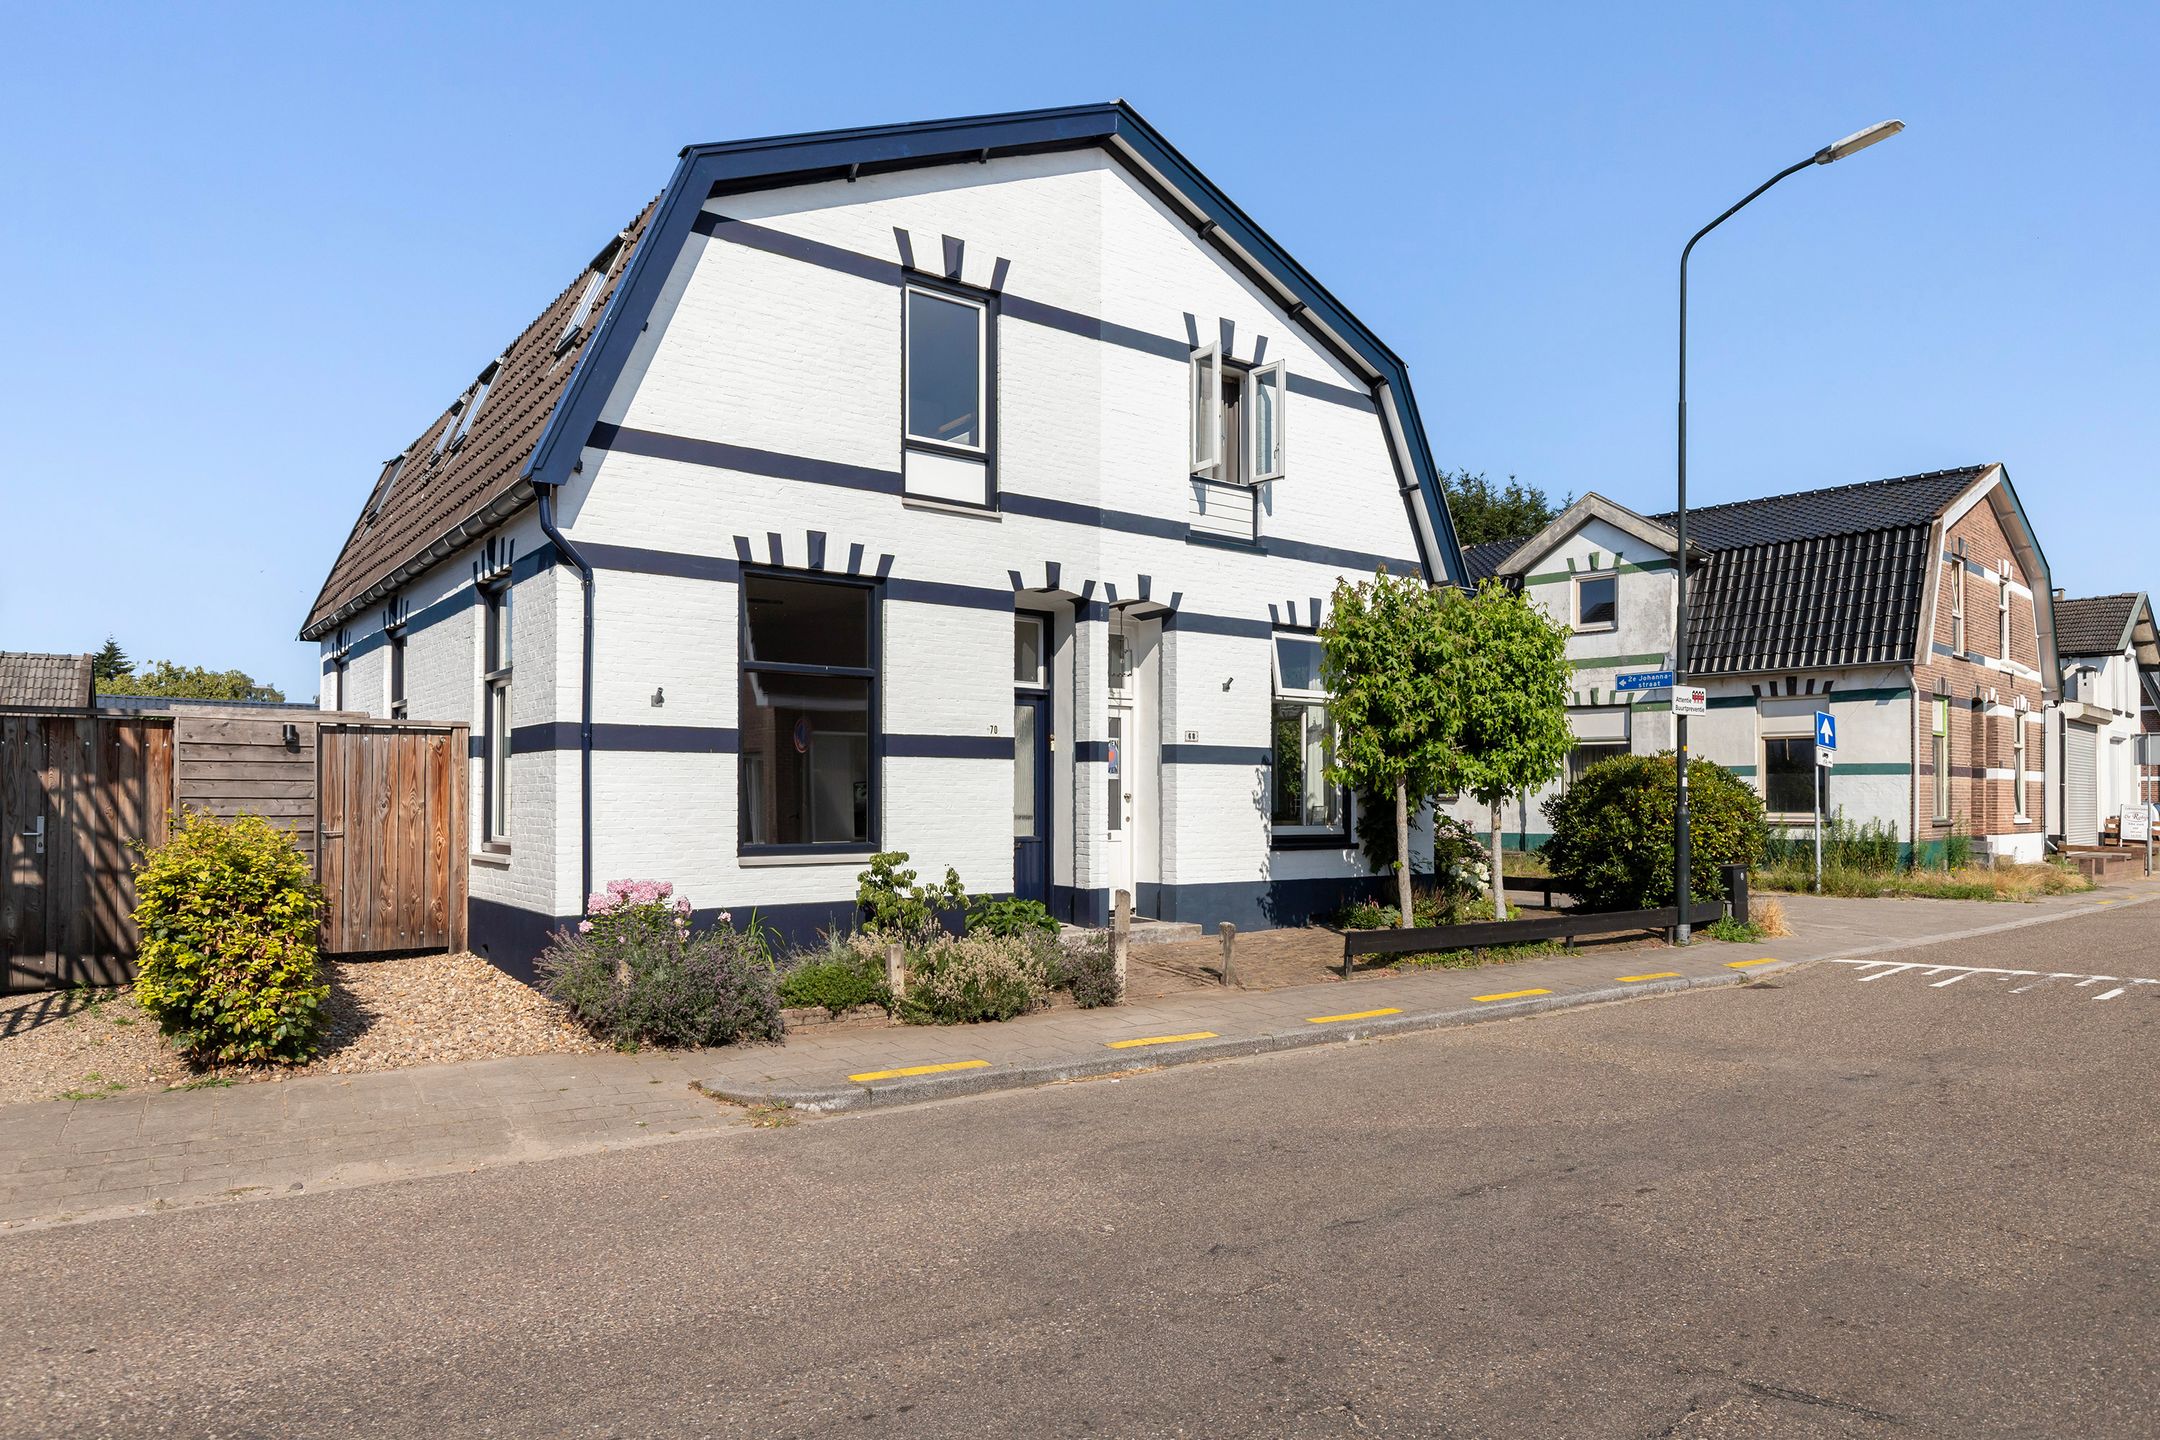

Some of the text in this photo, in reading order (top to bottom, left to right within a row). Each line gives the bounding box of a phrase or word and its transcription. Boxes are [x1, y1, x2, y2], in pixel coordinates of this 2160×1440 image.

[1638, 673, 1671, 682] Johanna-
[1676, 696, 1692, 704] Attentie
[1675, 704, 1705, 713] Buurtpreventie
[990, 725, 998, 735] 70
